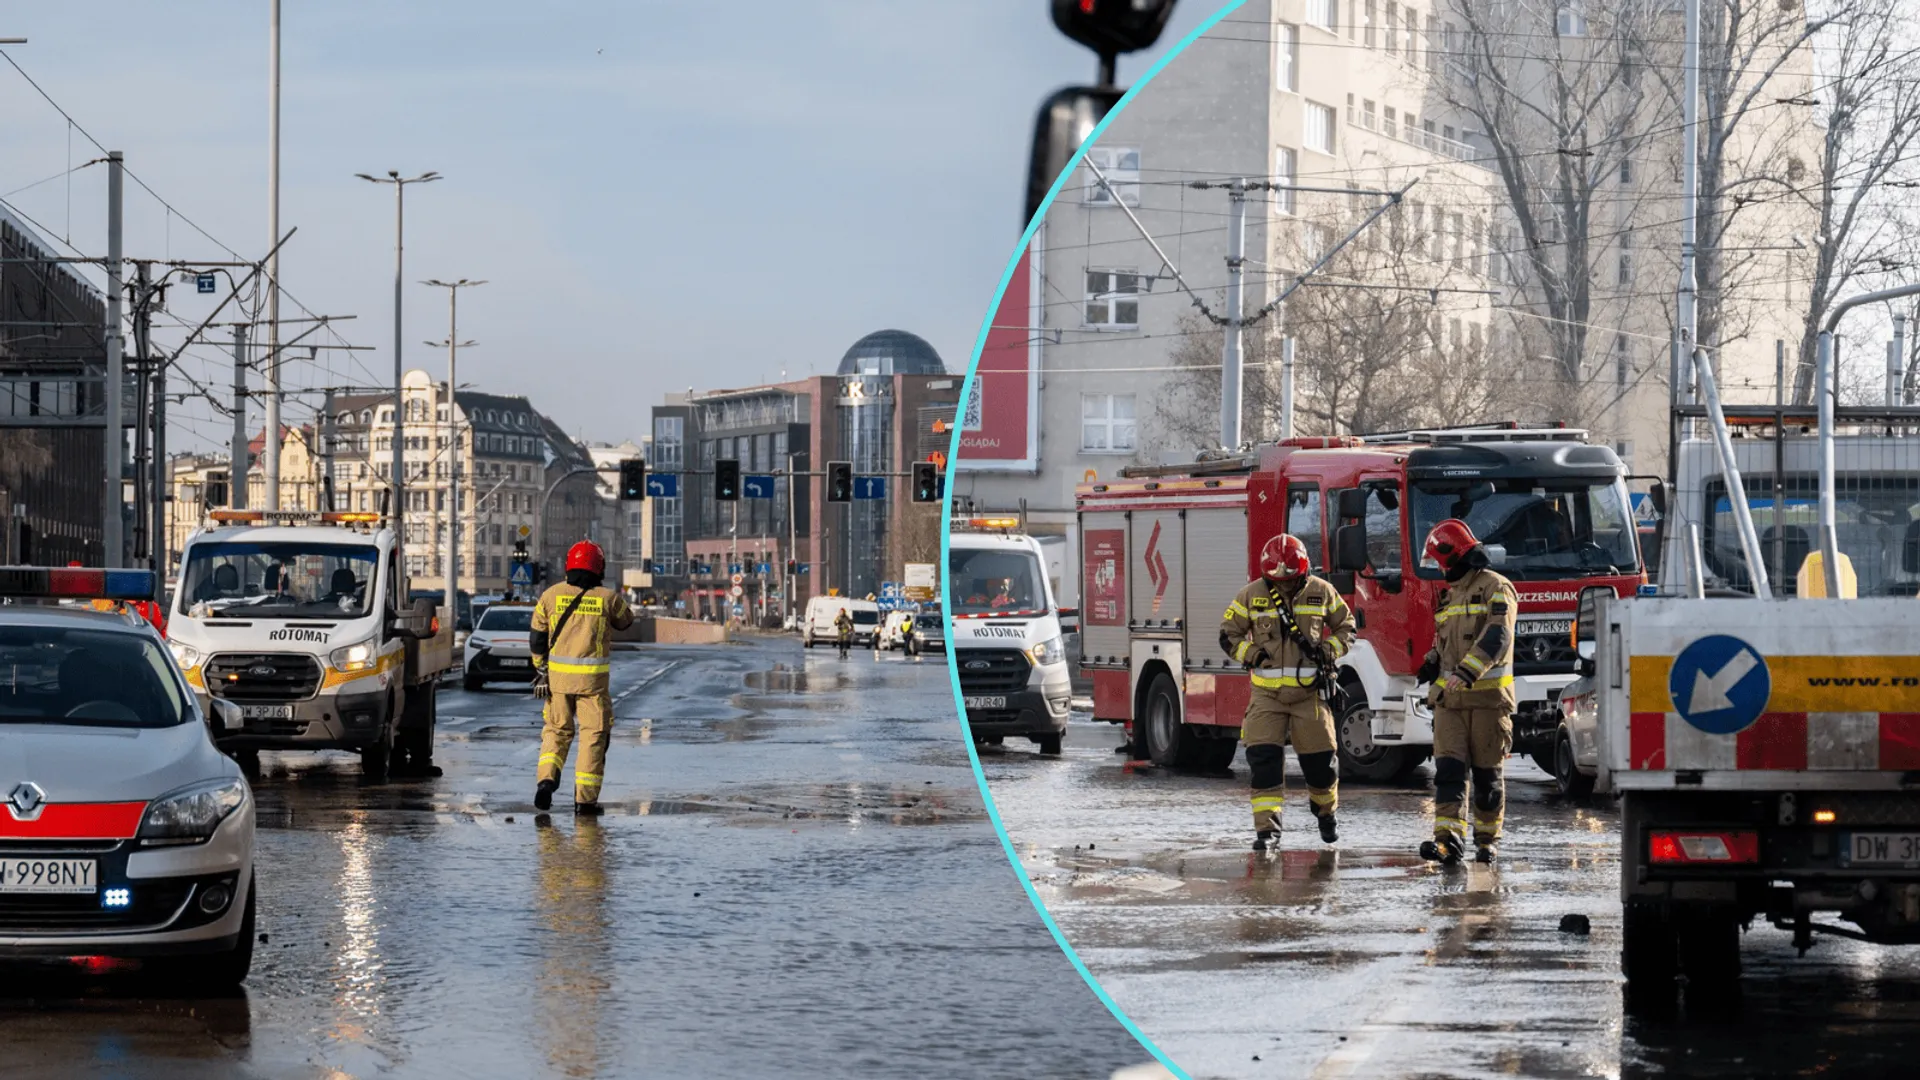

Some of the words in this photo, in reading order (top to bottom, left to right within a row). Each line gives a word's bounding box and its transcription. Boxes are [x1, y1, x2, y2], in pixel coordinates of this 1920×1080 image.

[266, 512, 318, 520] ROTOMAT
[973, 627, 1026, 639] ROTOMAT
[1520, 621, 1534, 633] DW
[1537, 620, 1570, 633] 7RK98
[269, 629, 330, 644] ROTOMAT
[1856, 835, 1889, 860] DW
[16, 861, 92, 885] 998NY
